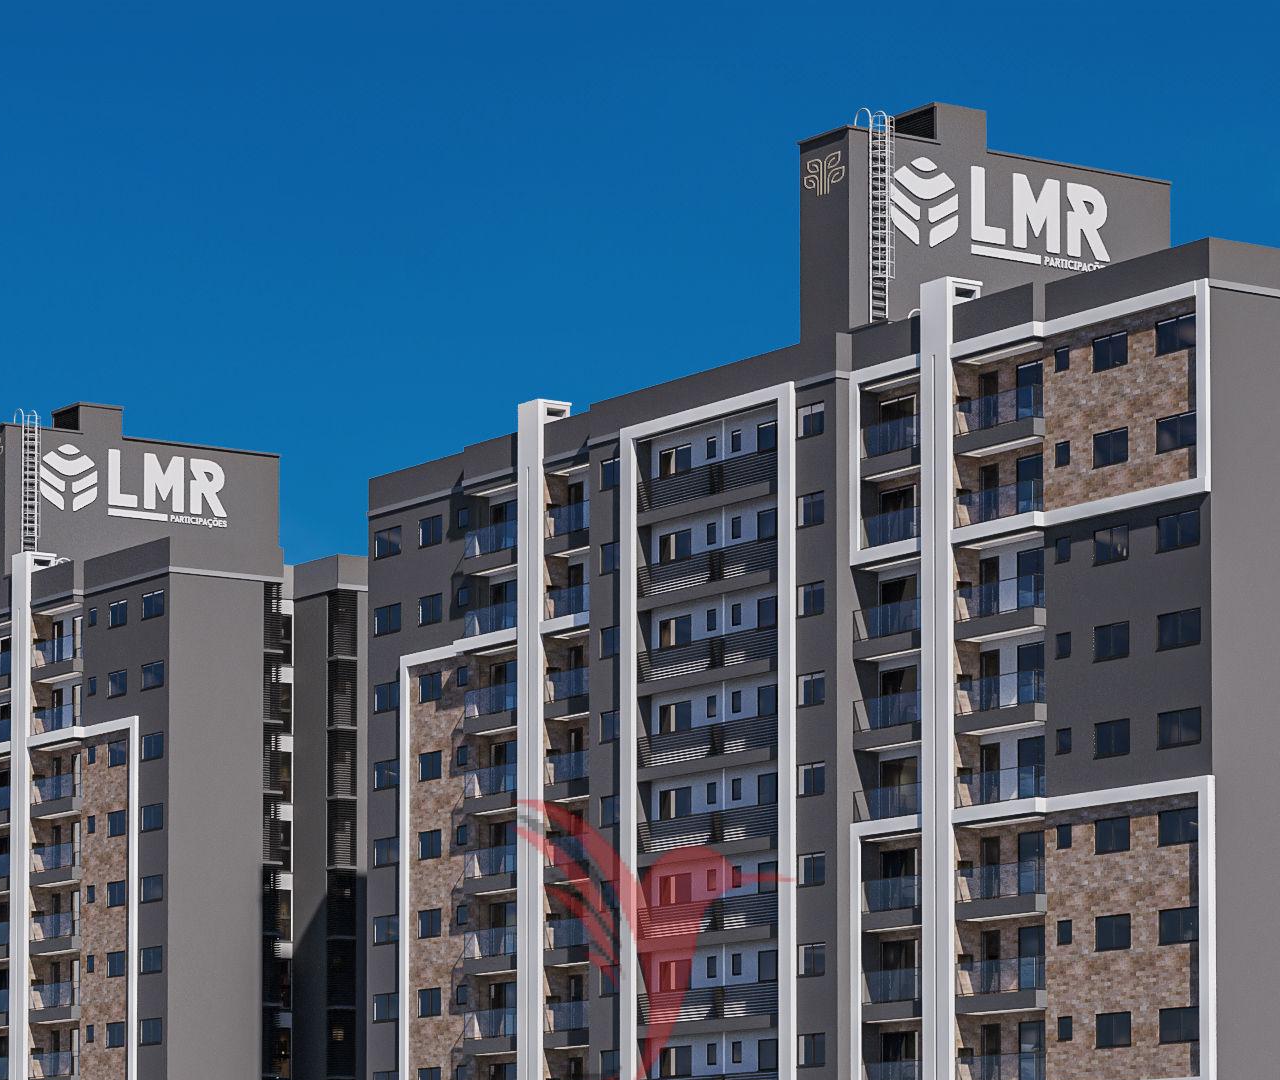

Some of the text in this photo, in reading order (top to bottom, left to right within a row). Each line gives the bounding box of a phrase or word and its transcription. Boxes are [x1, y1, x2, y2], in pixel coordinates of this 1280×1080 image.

[971, 166, 1111, 262] LMR
[1043, 256, 1106, 272] PARTICIPAÇÕ
[108, 449, 227, 518] LMR
[170, 514, 228, 529] PARTICIPAÇÕES
